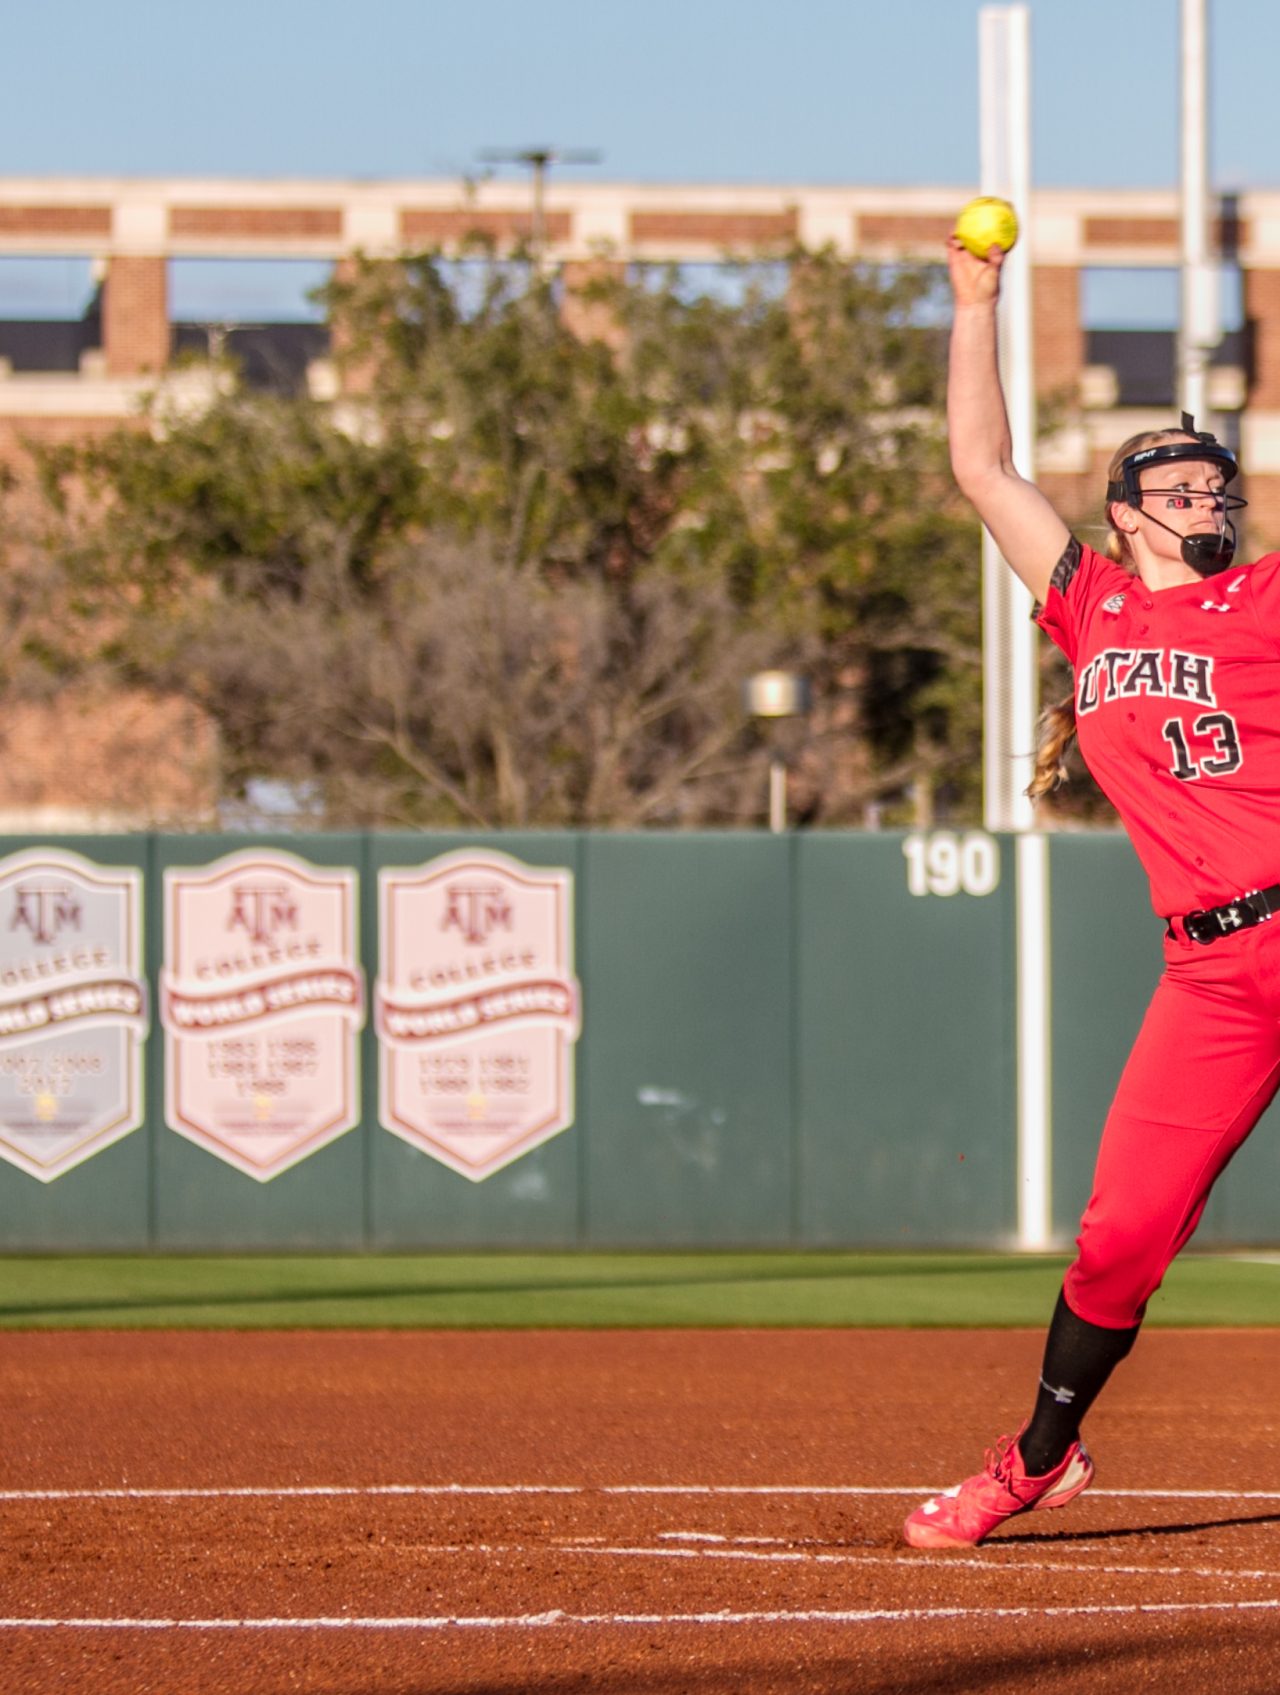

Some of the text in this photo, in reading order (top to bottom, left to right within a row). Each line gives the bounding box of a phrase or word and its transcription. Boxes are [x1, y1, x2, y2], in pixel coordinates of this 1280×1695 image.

[1077, 648, 1217, 716] UTAH
[1162, 710, 1244, 782] 13
[902, 832, 999, 897] 190
[194, 940, 321, 980] COLLEGE
[409, 951, 536, 993] COLLEGE
[173, 974, 355, 1028] WORLD SERIES
[386, 986, 569, 1037] WORLD SERIES
